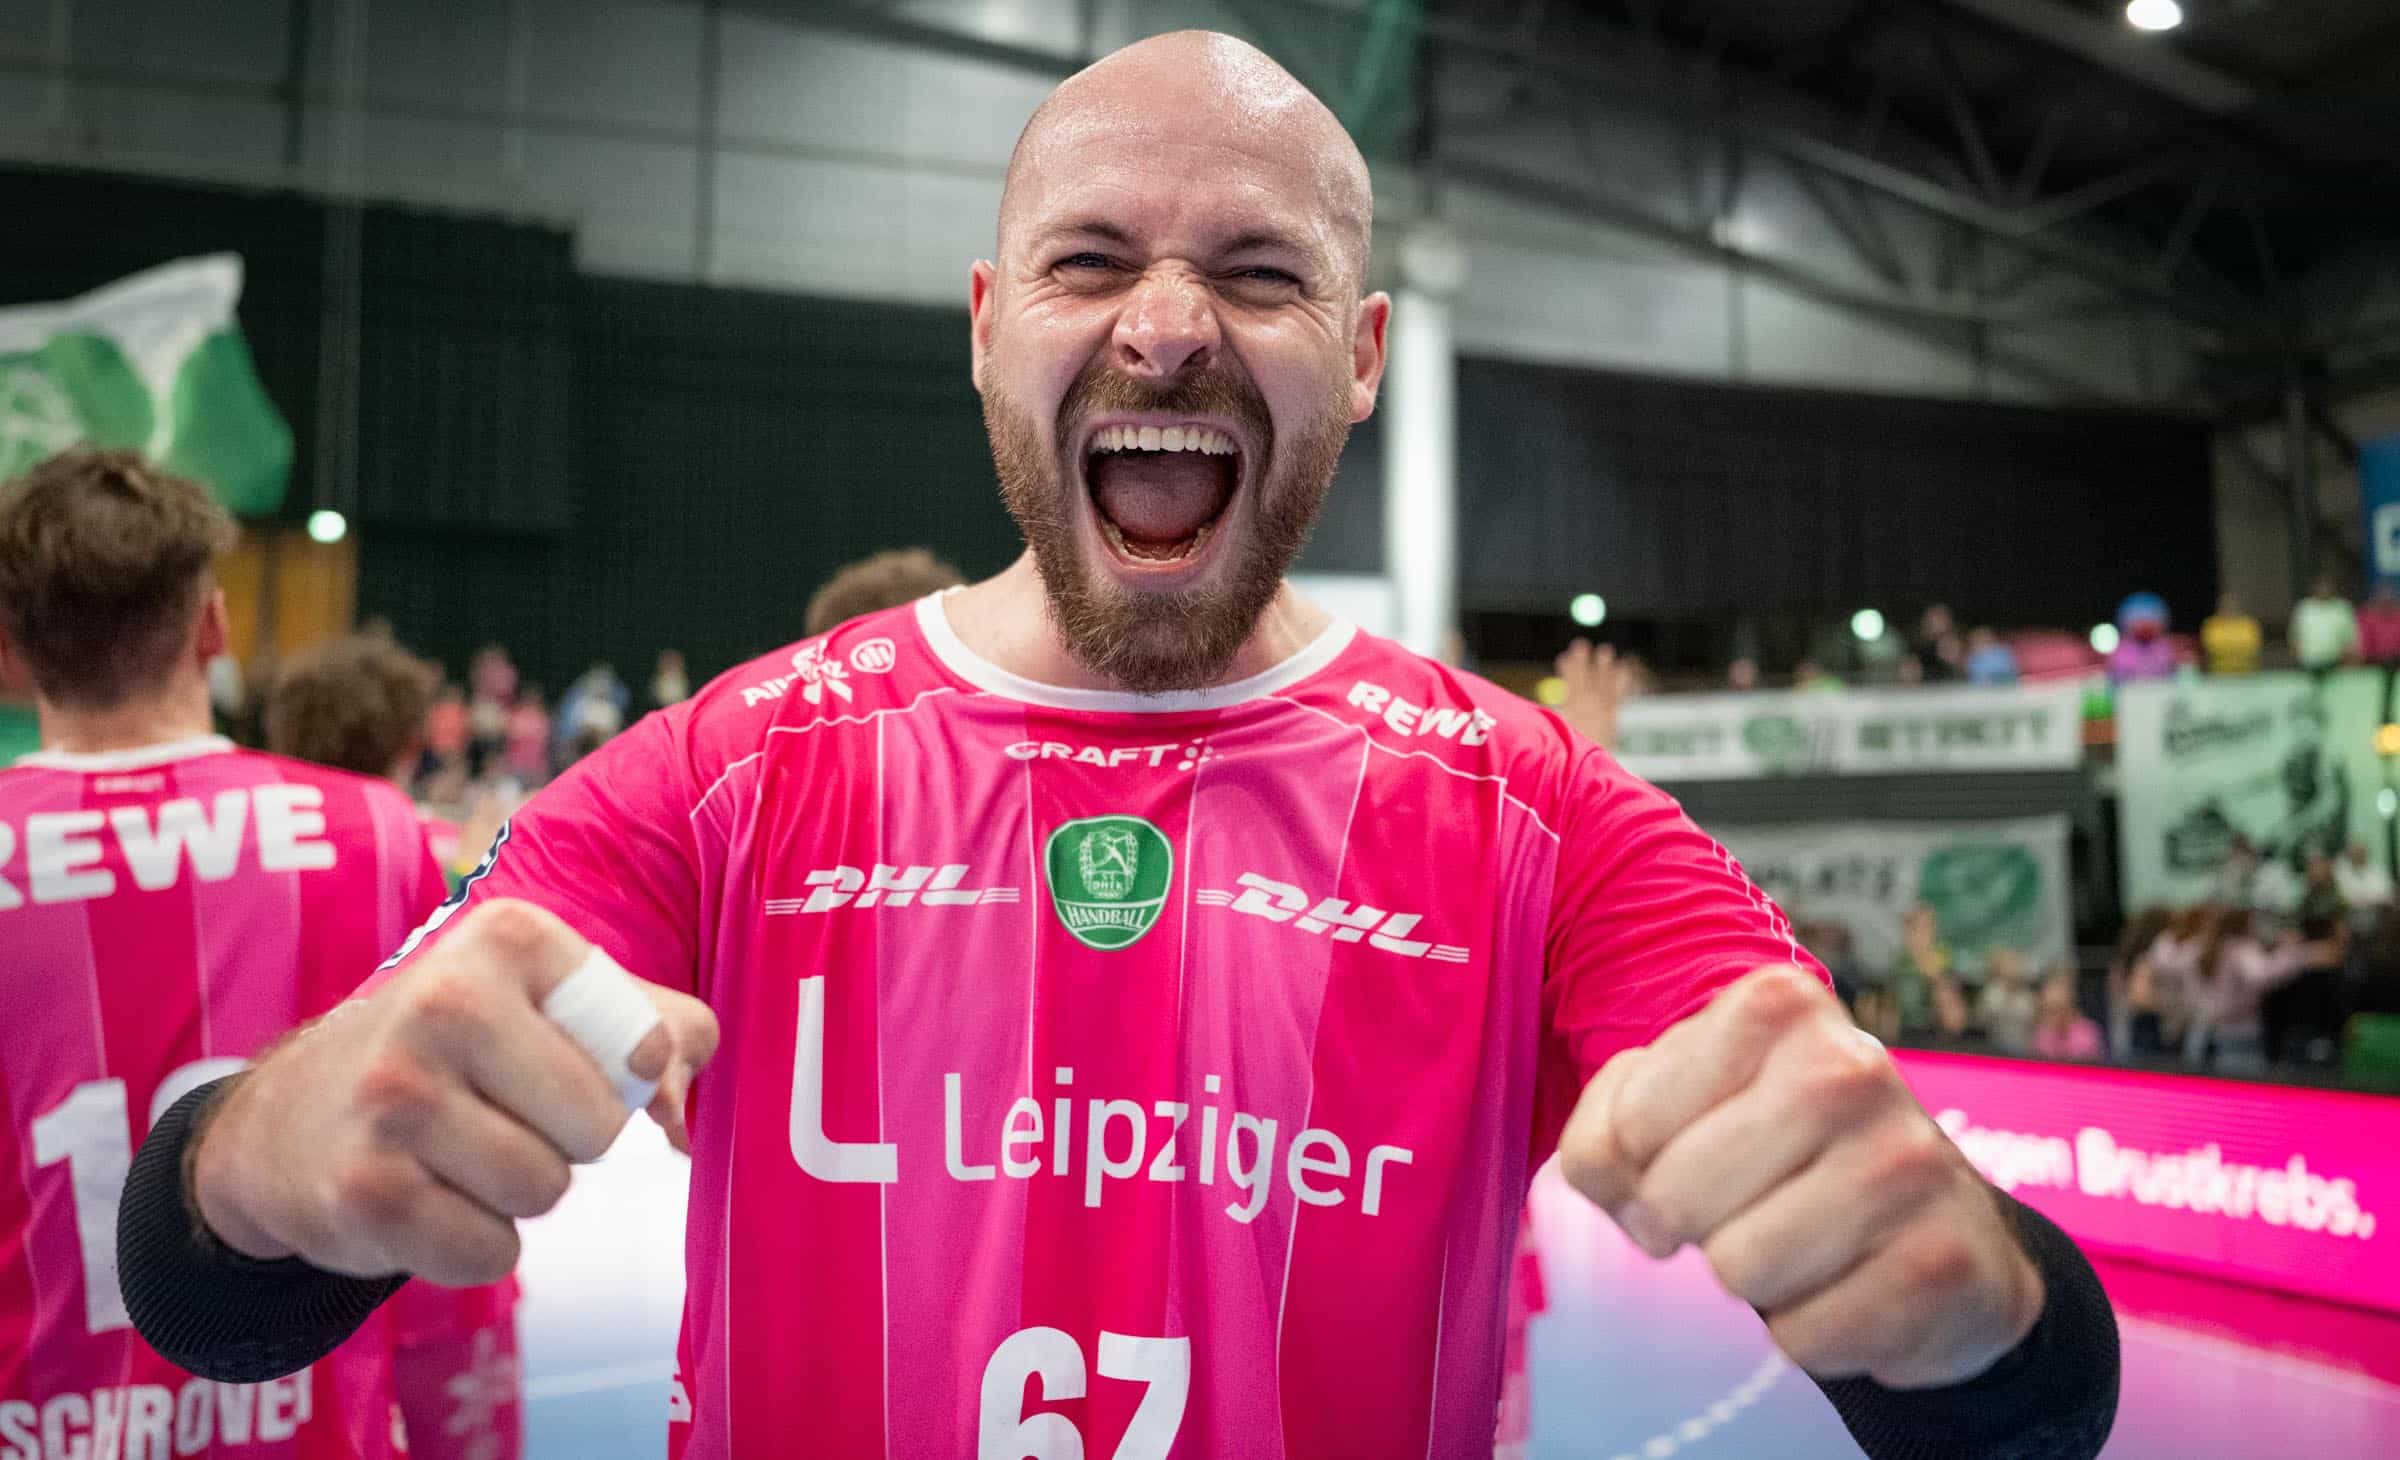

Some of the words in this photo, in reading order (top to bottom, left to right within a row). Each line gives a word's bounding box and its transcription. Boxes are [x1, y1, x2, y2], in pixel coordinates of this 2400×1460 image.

[1346, 680, 1497, 746] REWE
[1004, 740, 1180, 768] CRAFT
[801, 863, 982, 914] DHL
[1064, 904, 1145, 929] HANDBALL
[1231, 872, 1432, 958] DHL
[943, 1066, 1413, 1225] Leipziger
[32, 1057, 258, 1335] 1
[978, 1325, 1191, 1460] 67
